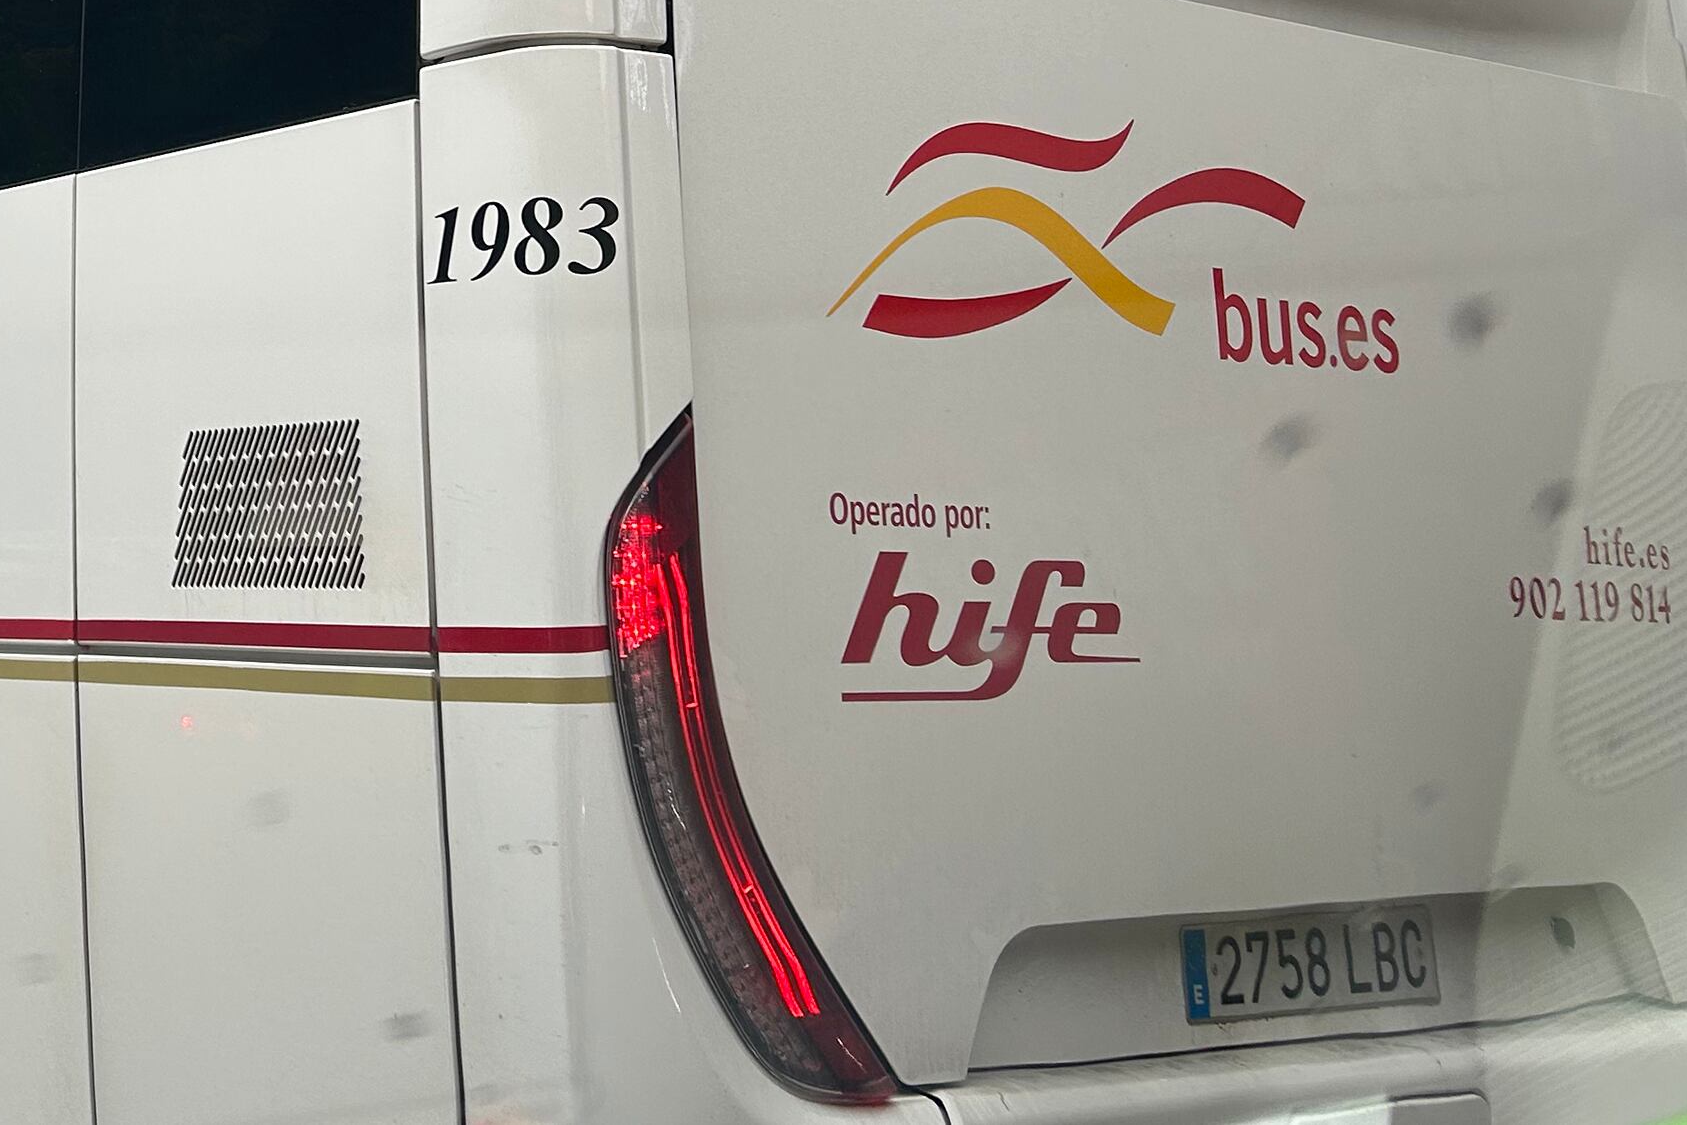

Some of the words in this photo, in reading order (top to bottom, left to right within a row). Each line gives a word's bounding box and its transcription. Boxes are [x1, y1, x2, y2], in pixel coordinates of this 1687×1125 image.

[427, 197, 619, 284] 1983
[1212, 267, 1399, 374] bus.es
[829, 492, 937, 534] Operado
[944, 503, 992, 538] por:
[1583, 525, 1670, 570] hife.es
[841, 551, 1141, 702] hife
[1510, 576, 1566, 621] 902
[1574, 579, 1620, 622] 119
[1630, 582, 1671, 625] 814
[1193, 984, 1205, 1005] E
[1216, 927, 1331, 1005] 2758
[1343, 918, 1427, 994] LBC
